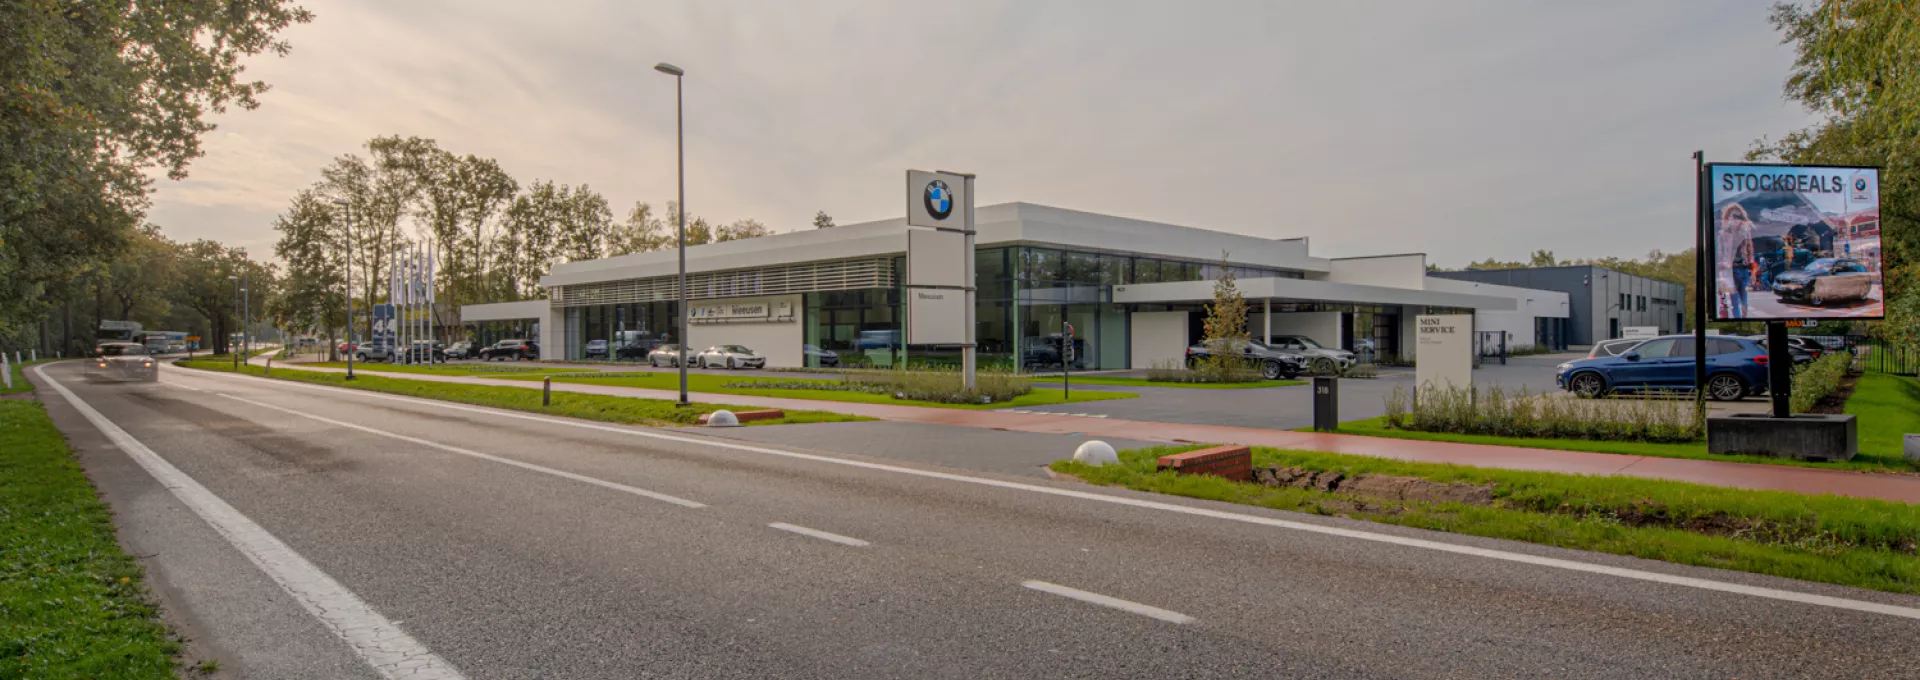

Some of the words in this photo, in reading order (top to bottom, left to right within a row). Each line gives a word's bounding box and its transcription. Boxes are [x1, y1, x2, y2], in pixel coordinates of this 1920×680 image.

[1722, 173, 1843, 193] STOCKDEALS
[731, 304, 763, 316] Meeusen
[1420, 317, 1440, 325] MINI
[1420, 326, 1455, 334] SERVICE
